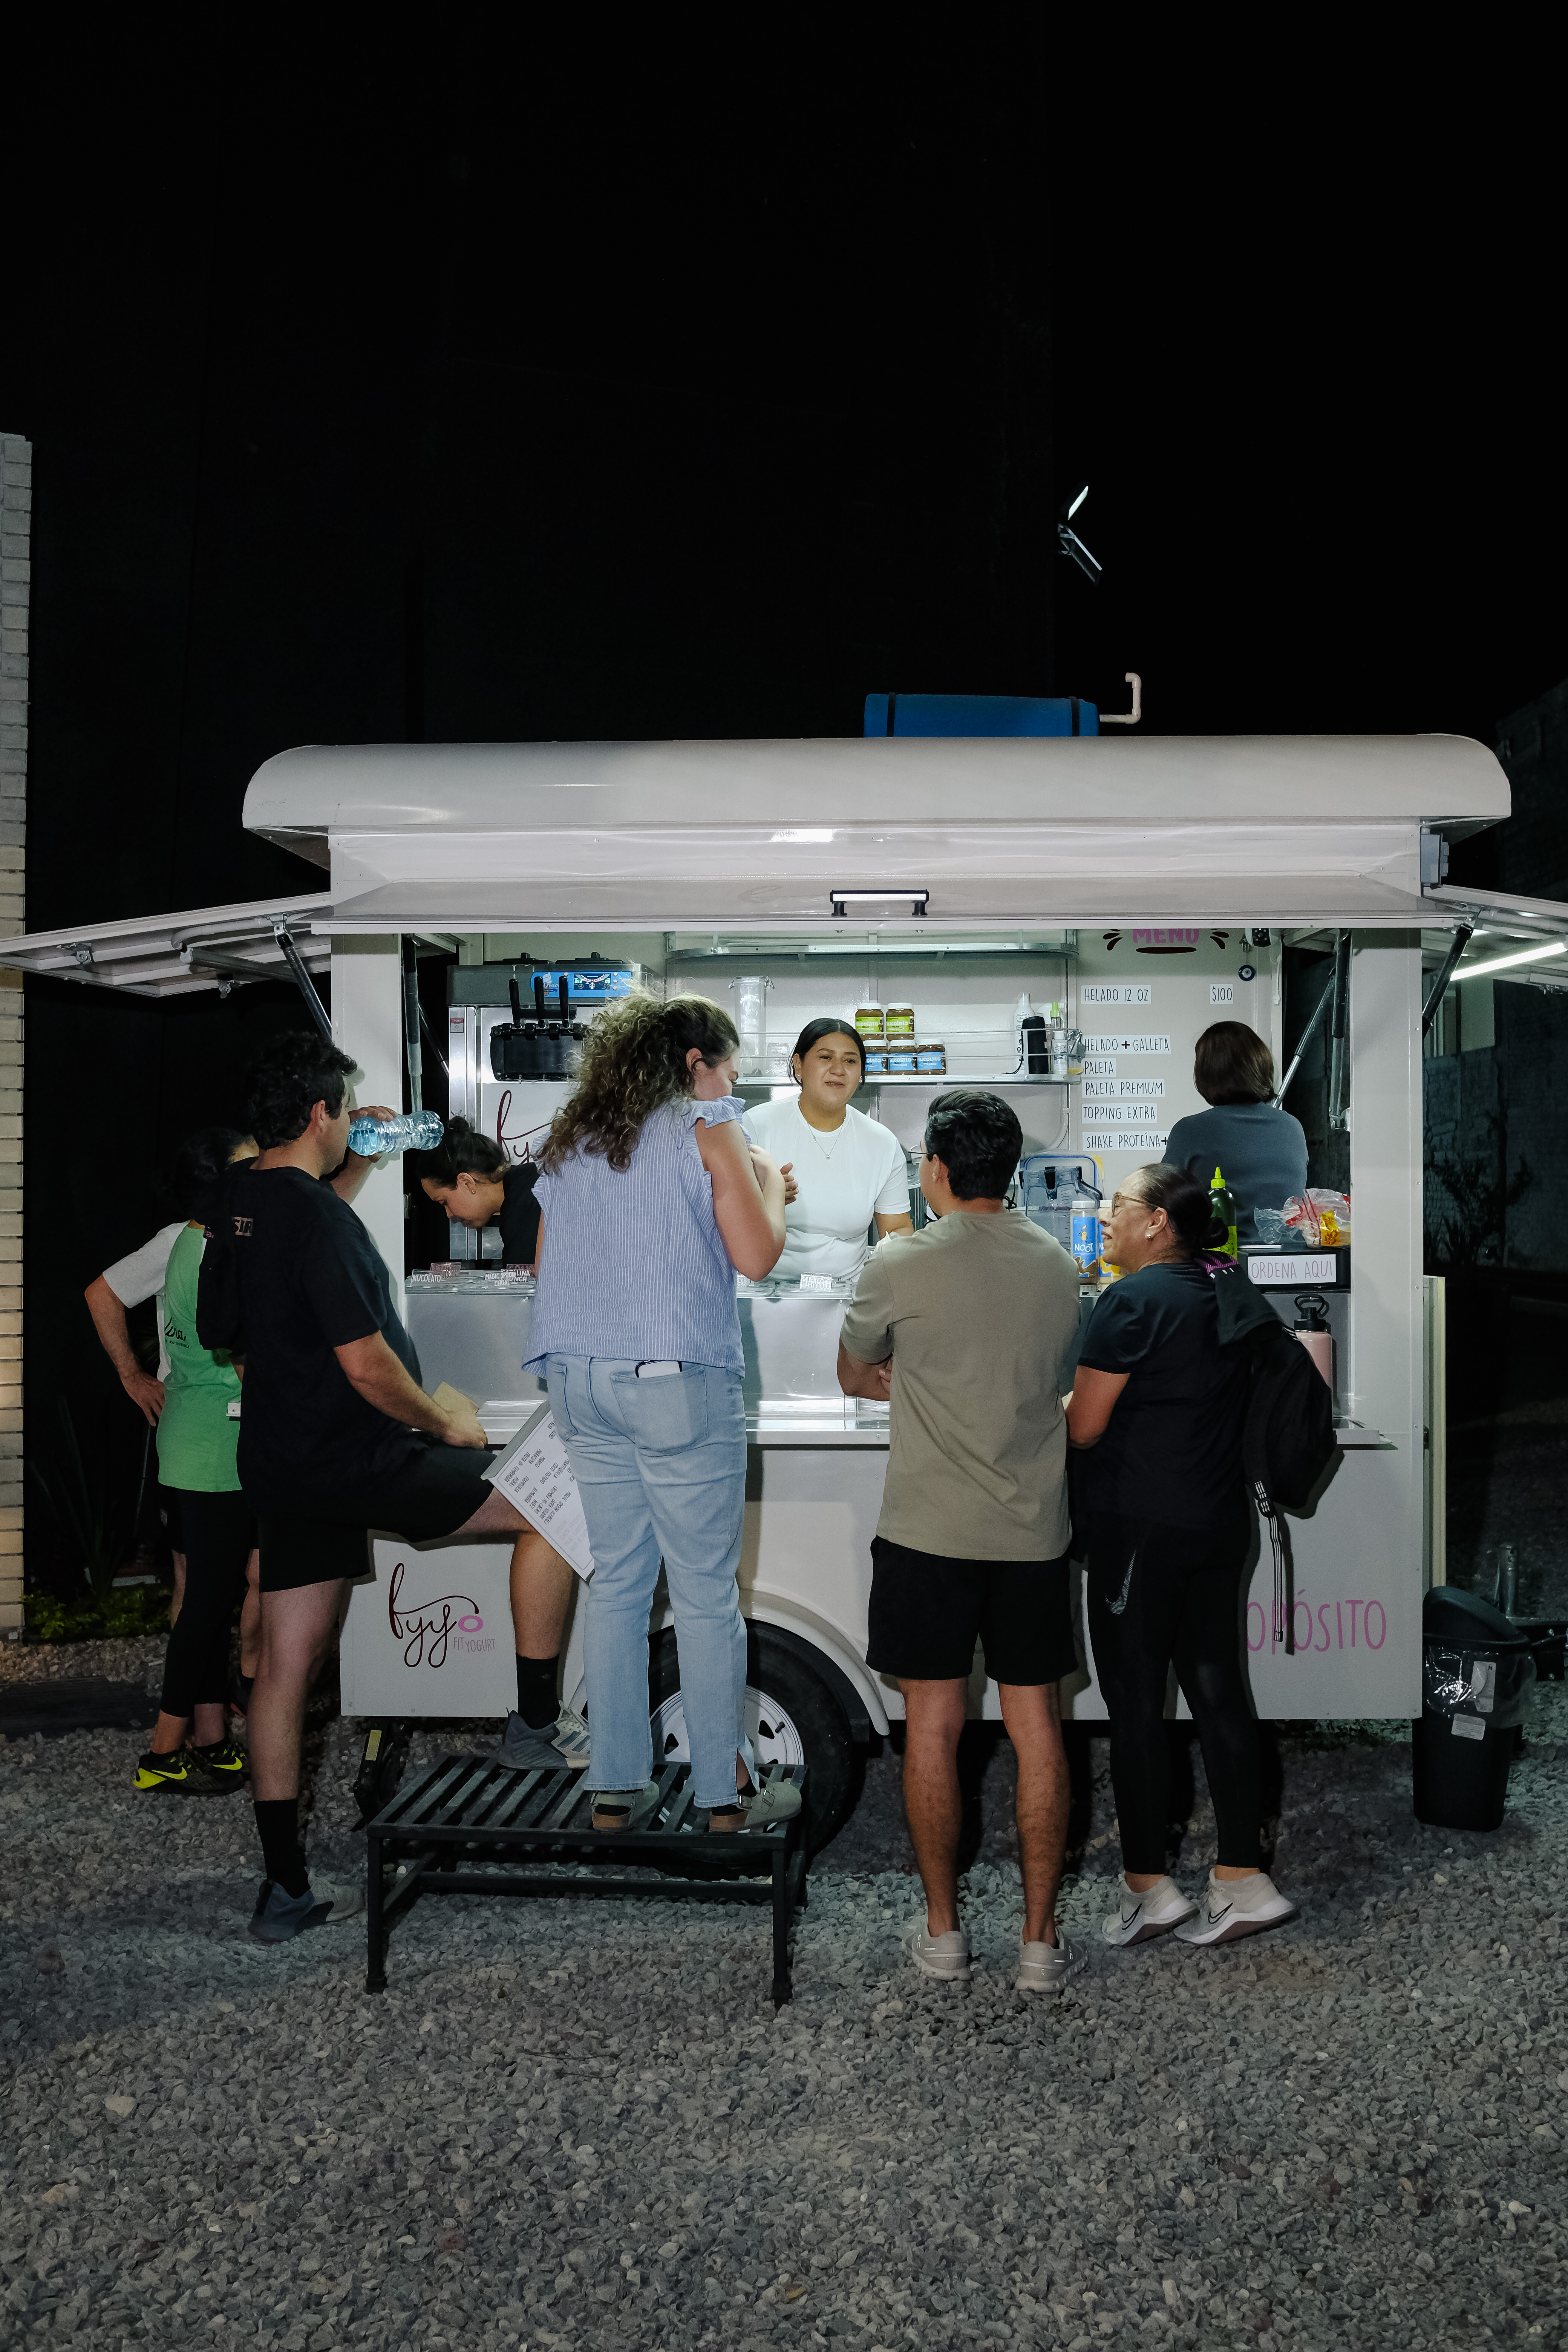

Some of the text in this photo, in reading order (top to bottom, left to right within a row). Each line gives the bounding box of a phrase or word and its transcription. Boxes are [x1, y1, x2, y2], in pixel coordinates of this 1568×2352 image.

[1085, 988, 1148, 1002] HELADO 12 OZ
[1212, 986, 1232, 1003] $100
[1084, 1038, 1118, 1052] HELADO
[1133, 1038, 1169, 1051] GALLETA
[1085, 1061, 1113, 1074] PALETA
[1086, 1081, 1162, 1095] PALETA PREMIUM
[1083, 1106, 1155, 1119] TOPPING EXTRA
[1086, 1135, 1113, 1148] SHAKE
[1075, 1243, 1093, 1253] NOOT
[1251, 1262, 1297, 1279] ORDENA
[1305, 1260, 1332, 1279] AQUI
[412, 1274, 441, 1282] NUCOLATO
[521, 1452, 530, 1462] FRUTA
[528, 1449, 542, 1464] MARACUYA
[535, 1456, 545, 1468] MANGO
[504, 1466, 519, 1482] TEMPORADA
[554, 1459, 570, 1478] MANTEQUILLA
[509, 1476, 519, 1488] MORAS
[514, 1476, 529, 1493] FRAMBUESA
[540, 1472, 551, 1484] TOSTADO
[525, 1487, 537, 1503] ALMENDRA
[546, 1485, 557, 1499] CRUMBLE
[562, 1491, 571, 1502] MAGIC
[534, 1503, 543, 1514] CACAO
[554, 1501, 563, 1512] SPOON
[389, 1563, 484, 1668] fyyo
[465, 1638, 496, 1652] YOGURT
